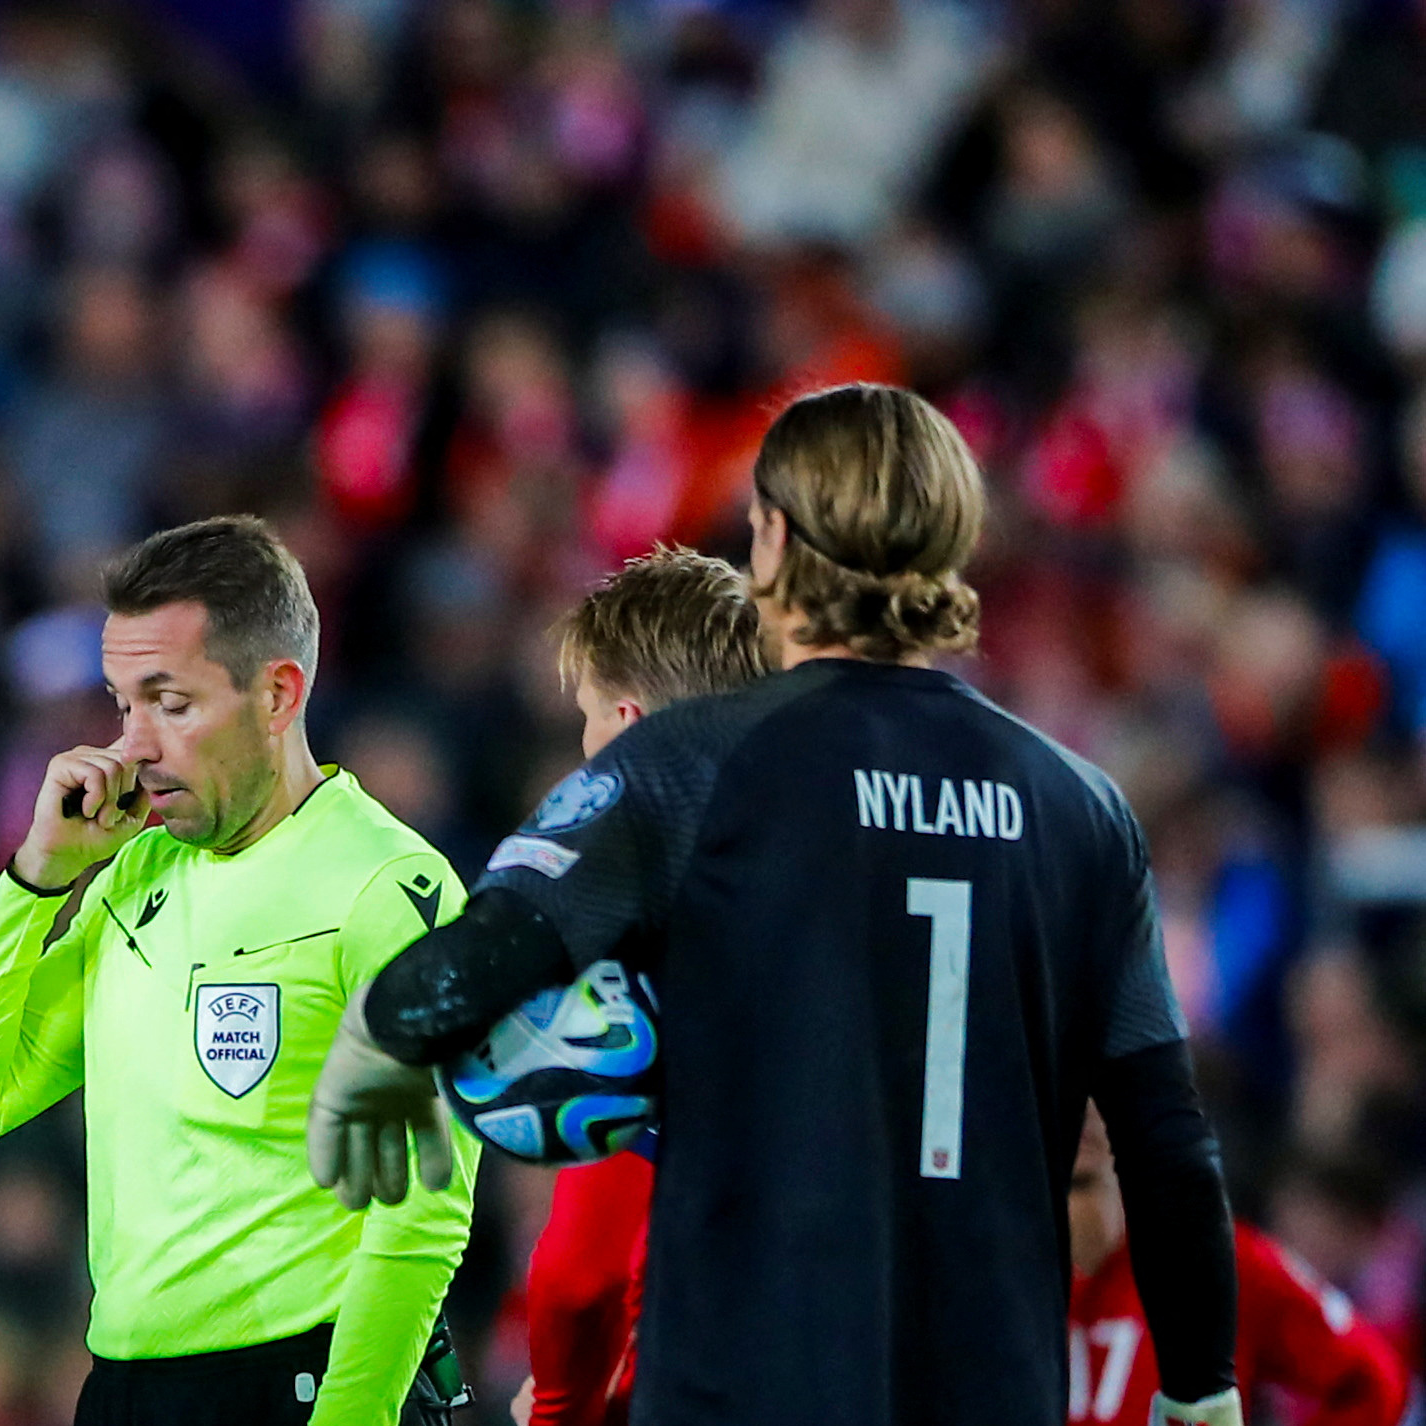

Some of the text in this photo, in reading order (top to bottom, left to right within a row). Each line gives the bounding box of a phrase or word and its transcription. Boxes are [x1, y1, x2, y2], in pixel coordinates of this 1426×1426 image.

[853, 769, 1024, 841] NYLAND
[211, 997, 259, 1018] UEFA
[212, 1031, 260, 1043] MATCH
[905, 877, 973, 1180] 1
[206, 1048, 266, 1060] OFFICIAL
